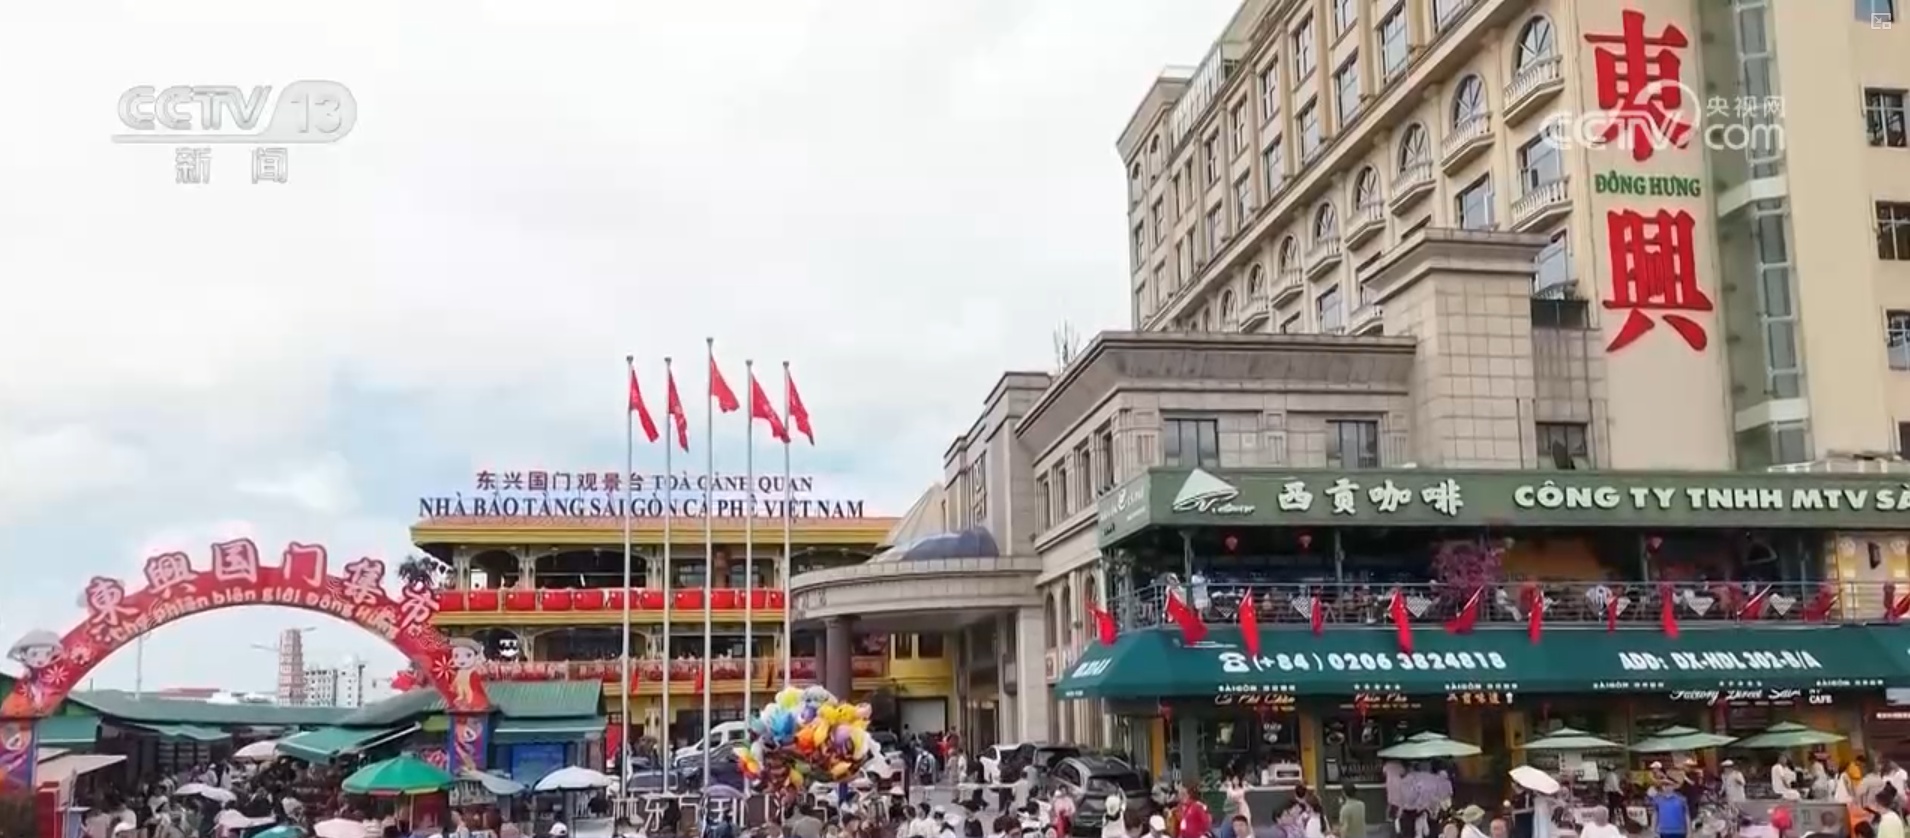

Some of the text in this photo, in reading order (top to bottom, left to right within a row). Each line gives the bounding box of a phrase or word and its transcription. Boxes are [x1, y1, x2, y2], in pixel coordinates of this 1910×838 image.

[1595, 170, 1647, 196] ĐÔNG
[419, 491, 466, 517] NHÀ
[522, 491, 584, 517] TÀNG
[816, 500, 864, 518] NAM
[1278, 478, 1464, 517] 西贡咖啡
[1514, 480, 1620, 510] CÔNG
[1630, 487, 1676, 510] TY
[1687, 487, 1783, 510] TNHH
[1792, 488, 1868, 510] MTV
[1327, 652, 1392, 671] 0206
[1396, 651, 1507, 671] 3824818
[1618, 651, 1669, 671] ADD:
